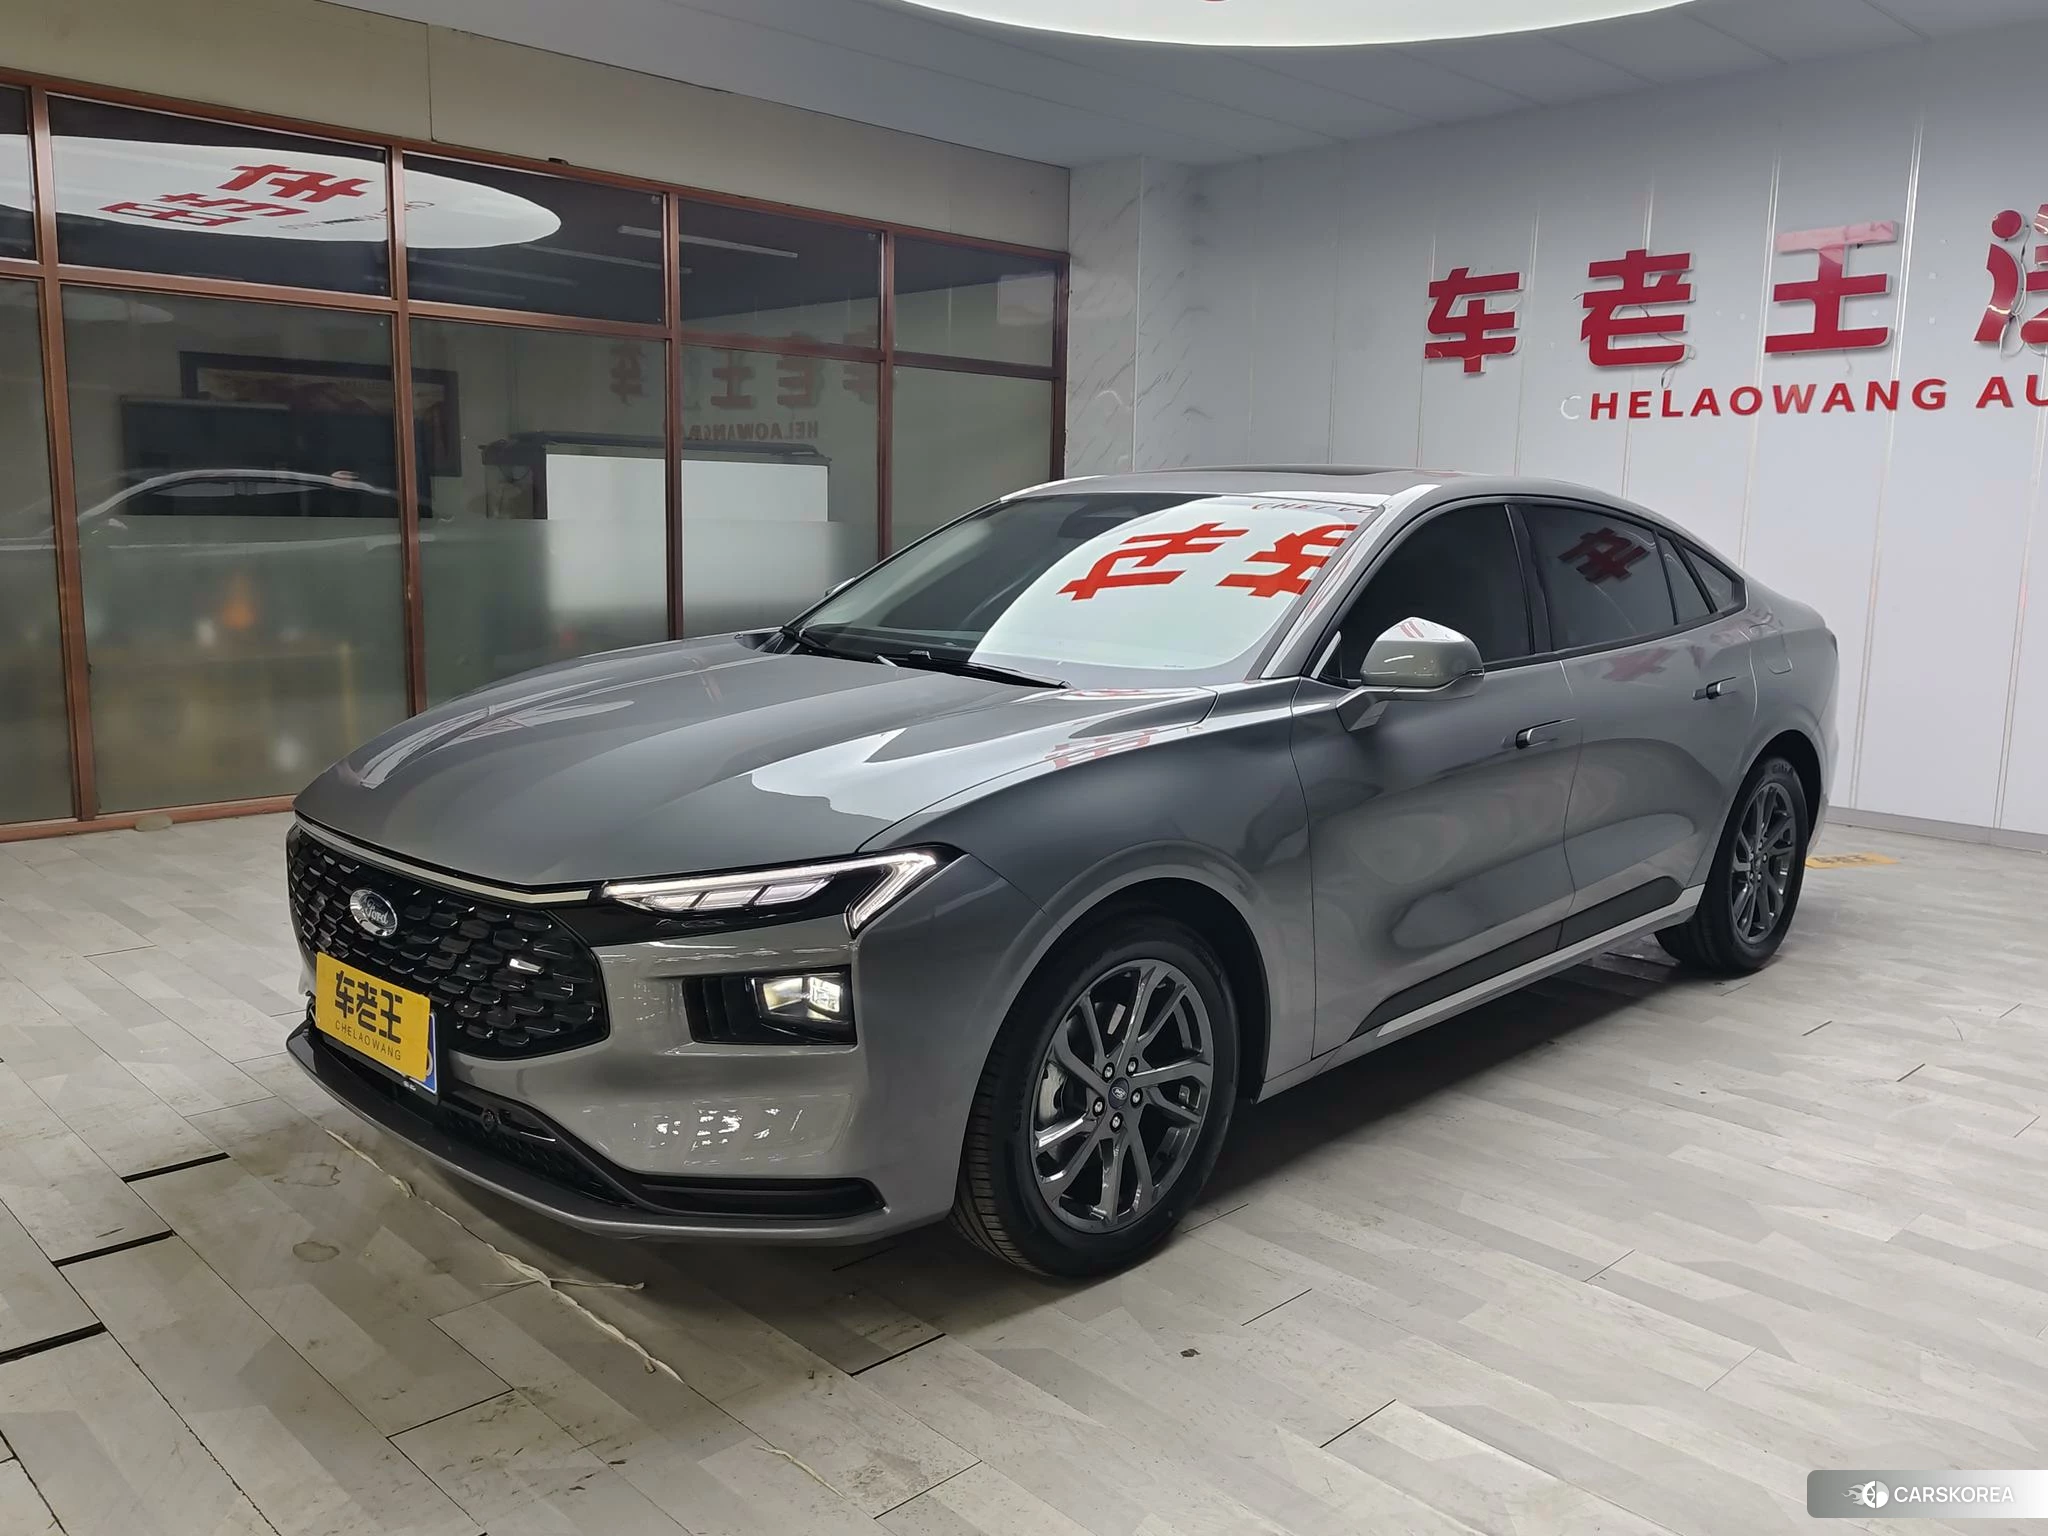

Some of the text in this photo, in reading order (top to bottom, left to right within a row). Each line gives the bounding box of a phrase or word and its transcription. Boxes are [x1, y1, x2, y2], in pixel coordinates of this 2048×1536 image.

[334, 970, 403, 1044] 车老王
[335, 1020, 401, 1061] CHELAOWANG
